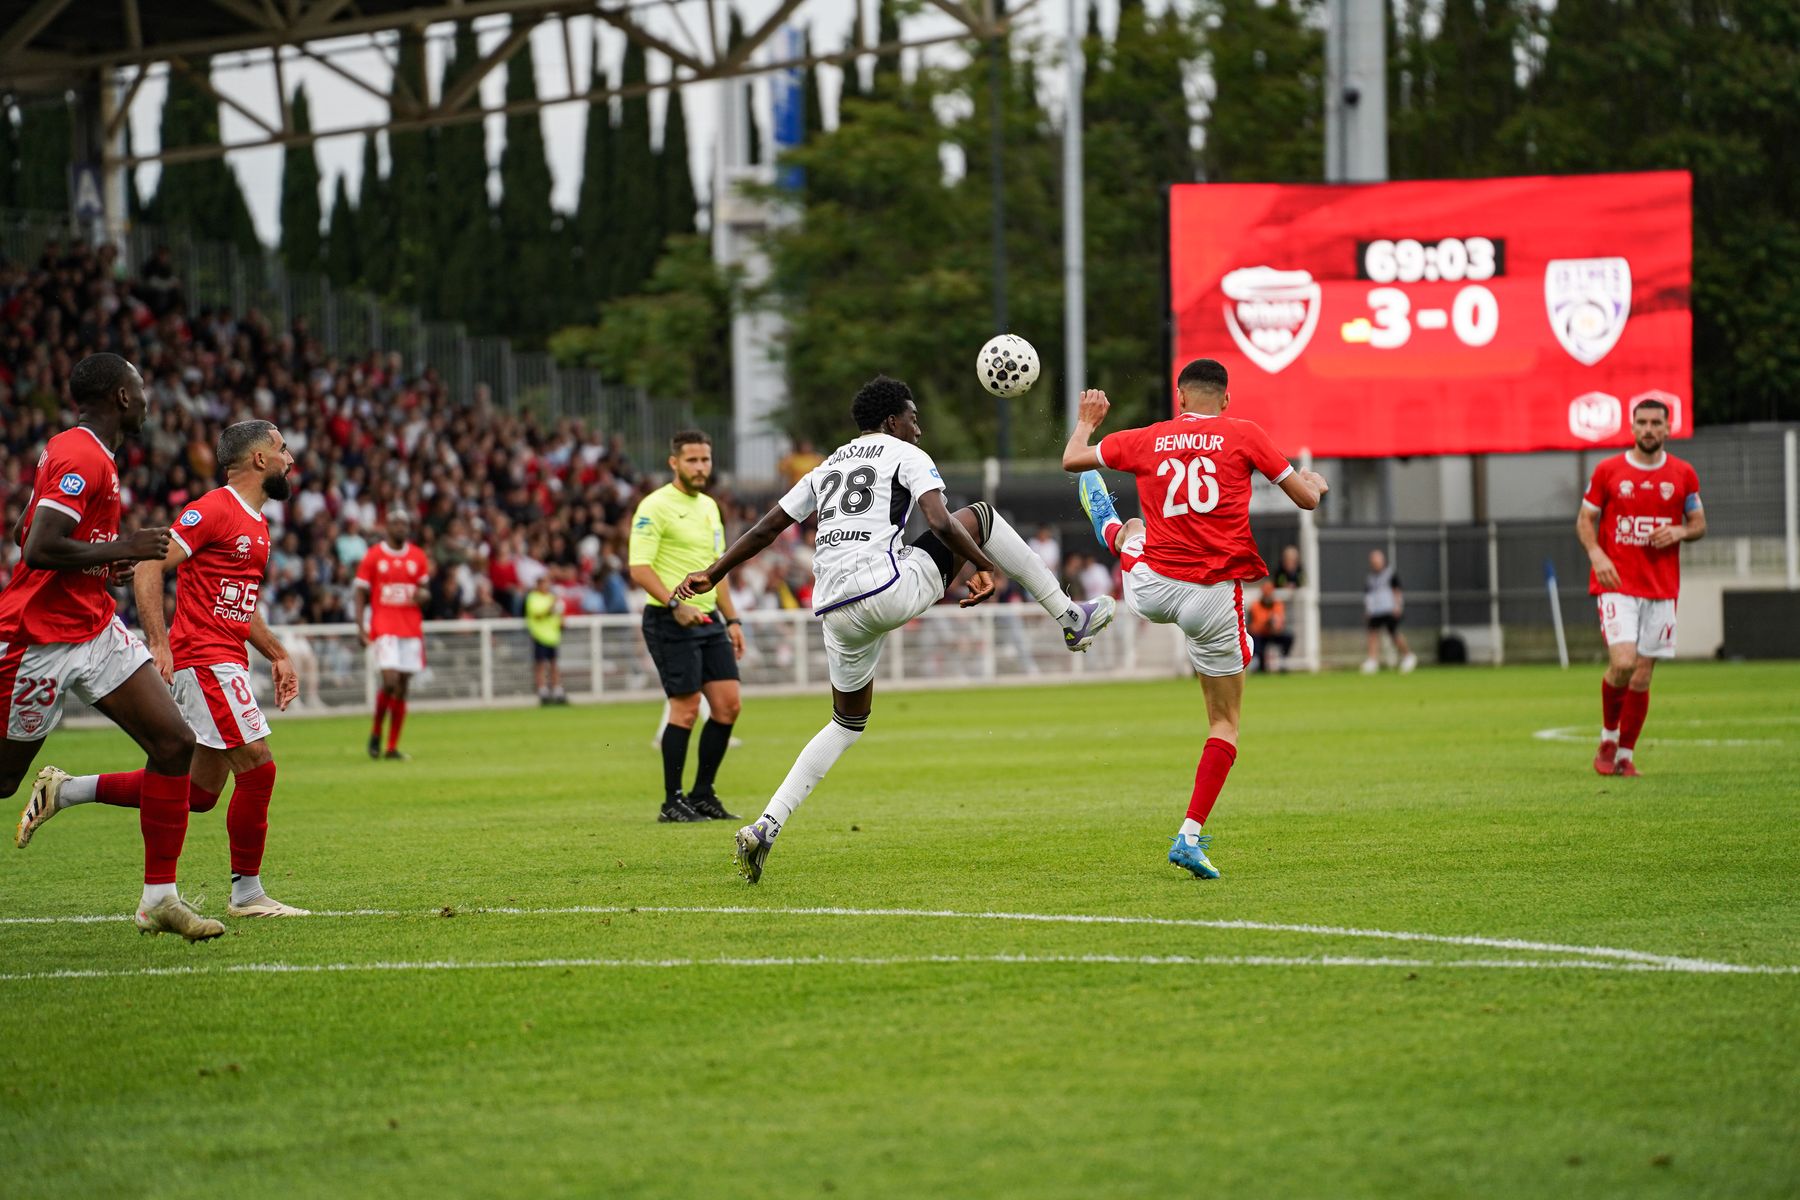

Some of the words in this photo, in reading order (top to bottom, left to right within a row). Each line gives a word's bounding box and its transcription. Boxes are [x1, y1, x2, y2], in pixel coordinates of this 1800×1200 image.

[1365, 236, 1496, 283] 69:03
[1155, 433, 1224, 452] BENNOUR
[64, 477, 81, 491] N2
[818, 465, 878, 523] 28
[1156, 456, 1219, 519] 26
[183, 512, 198, 523] N2
[14, 677, 57, 706] 23
[231, 676, 252, 706] 8
